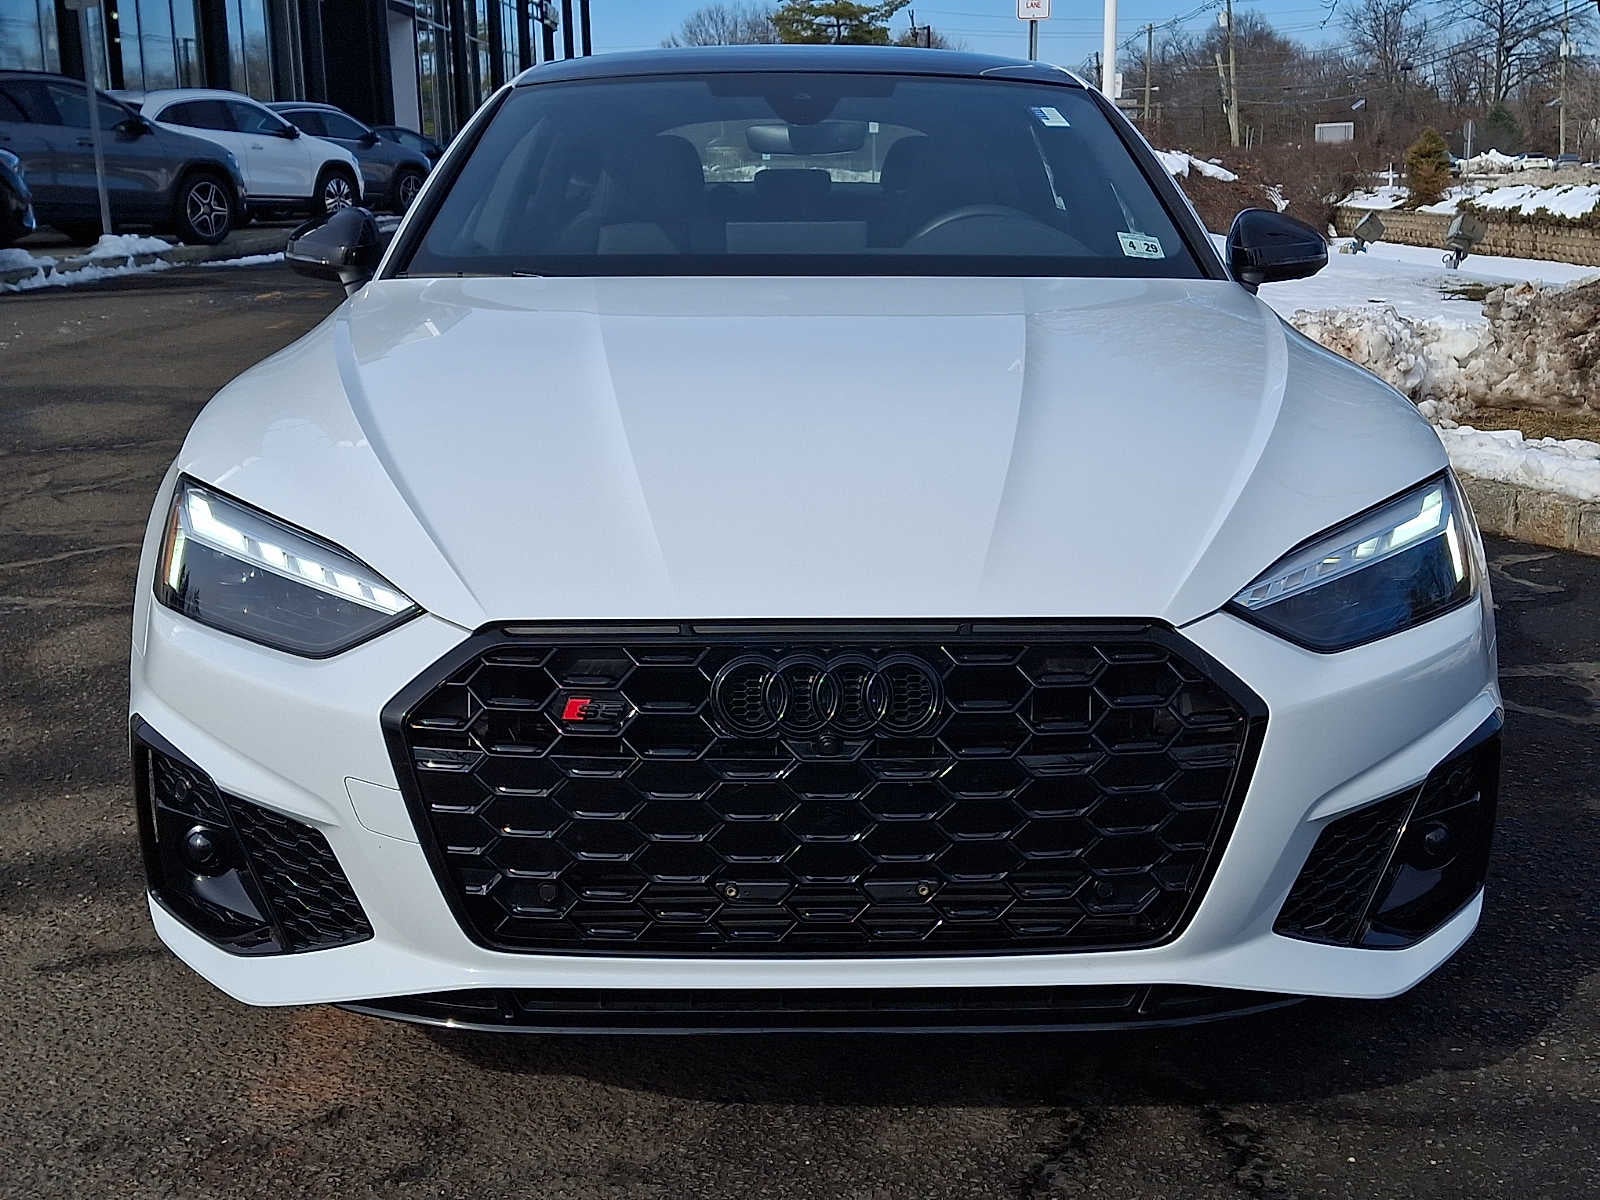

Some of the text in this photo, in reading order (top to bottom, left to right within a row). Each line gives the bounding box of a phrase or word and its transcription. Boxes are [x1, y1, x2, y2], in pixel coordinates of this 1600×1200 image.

[1128, 241, 1158, 253] 4 29
[575, 700, 624, 720] S5
